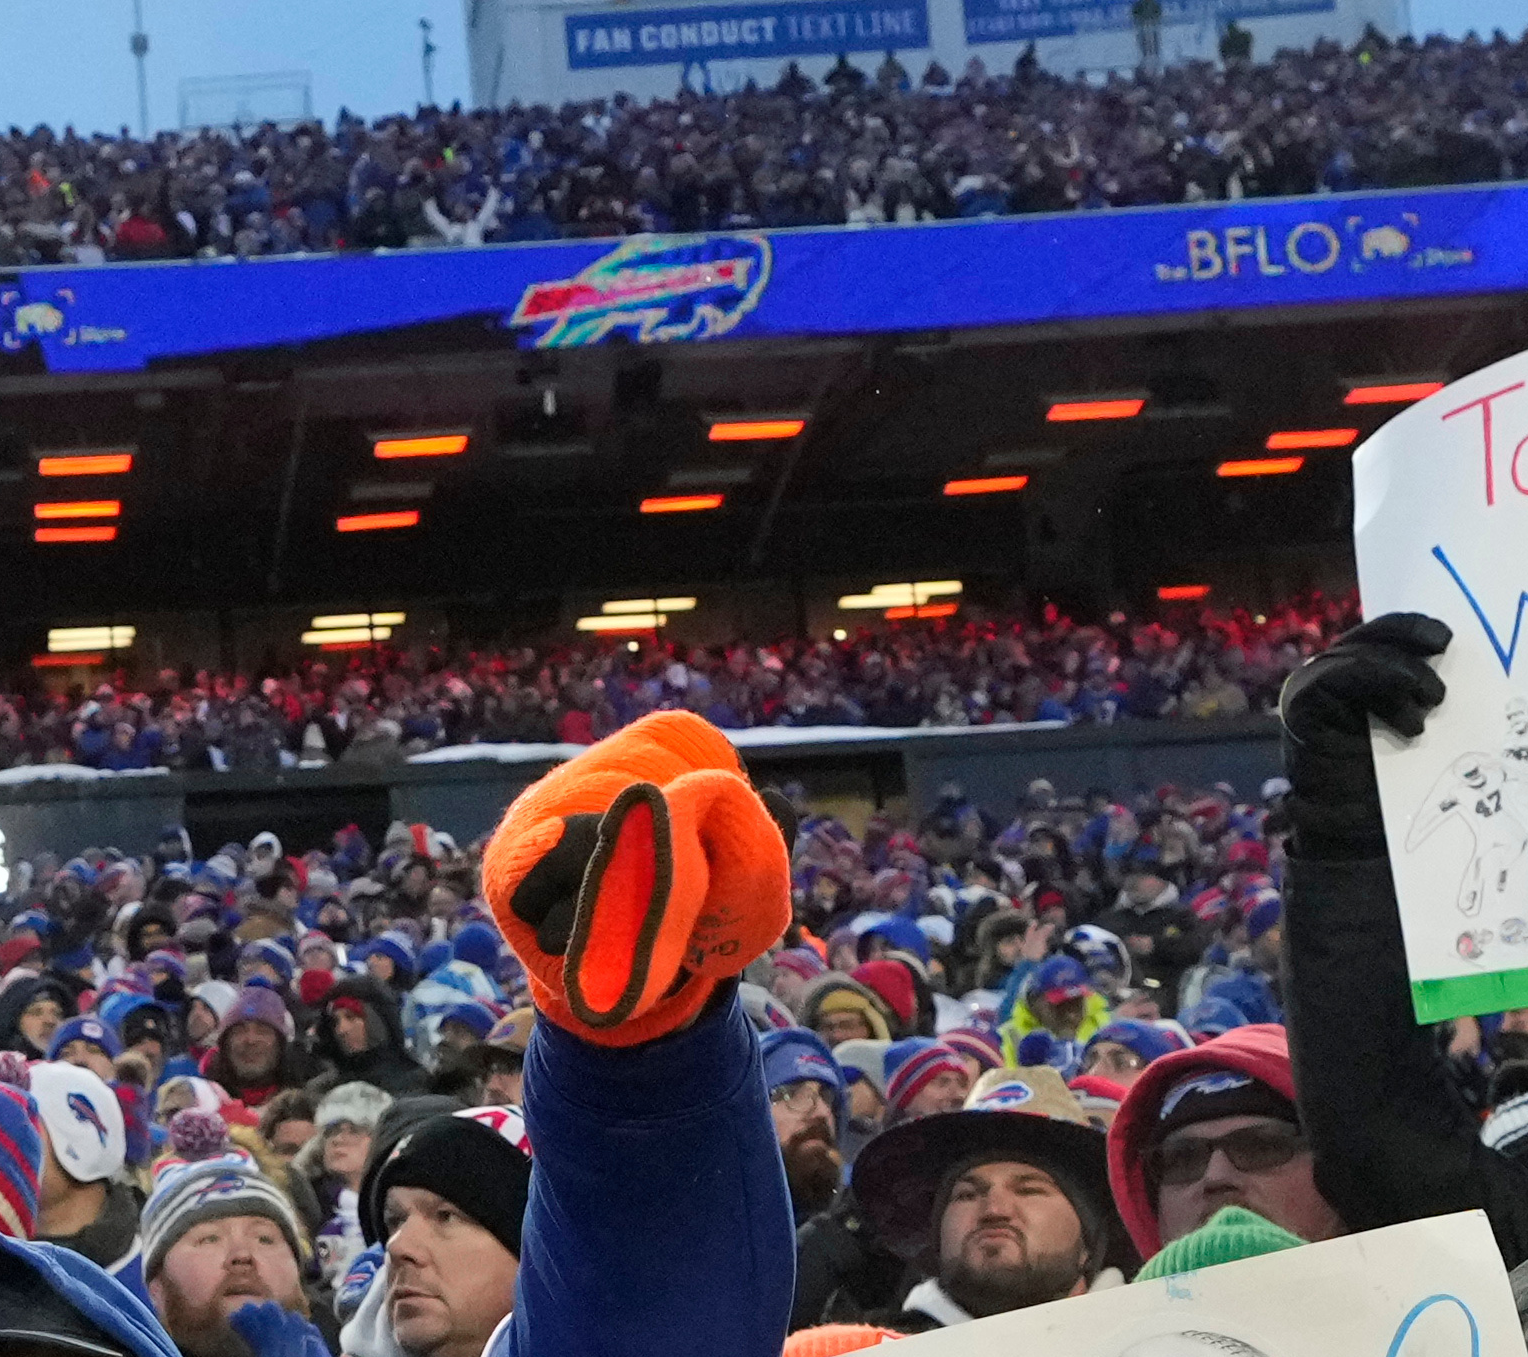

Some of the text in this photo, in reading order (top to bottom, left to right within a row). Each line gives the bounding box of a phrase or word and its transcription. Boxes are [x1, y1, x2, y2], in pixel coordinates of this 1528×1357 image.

[576, 29, 632, 53] FAN
[639, 17, 777, 50] CONDUCT
[1185, 221, 1341, 281] BFLO
